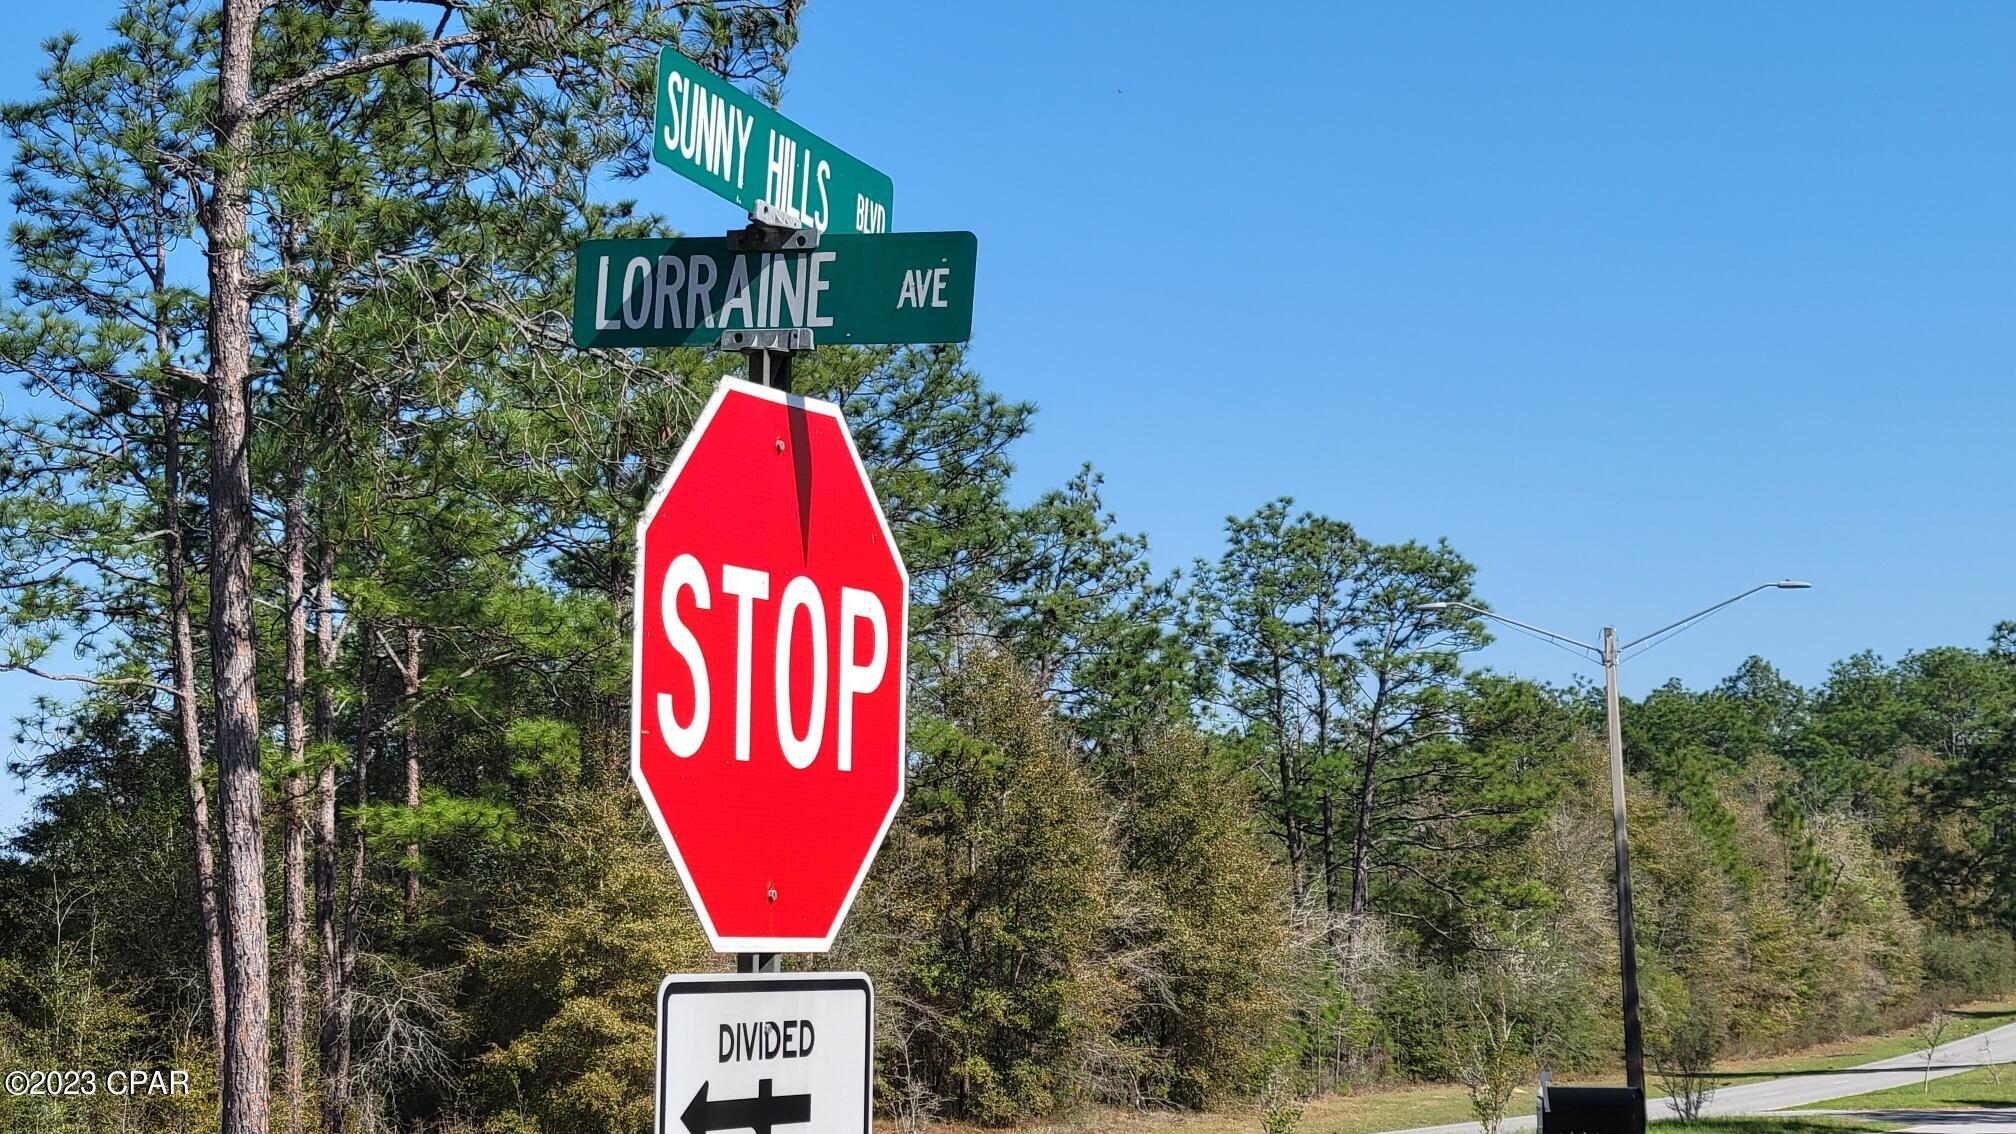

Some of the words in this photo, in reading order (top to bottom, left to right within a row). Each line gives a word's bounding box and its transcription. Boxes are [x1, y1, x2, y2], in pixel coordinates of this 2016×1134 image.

[663, 71, 754, 189] SUNNY
[766, 129, 830, 232] HILLS
[856, 193, 885, 233] BLVD
[595, 252, 836, 330] LORRAINE
[897, 268, 949, 309] AVE
[657, 553, 888, 771] STOP
[718, 1019, 815, 1063] DIVIDED
